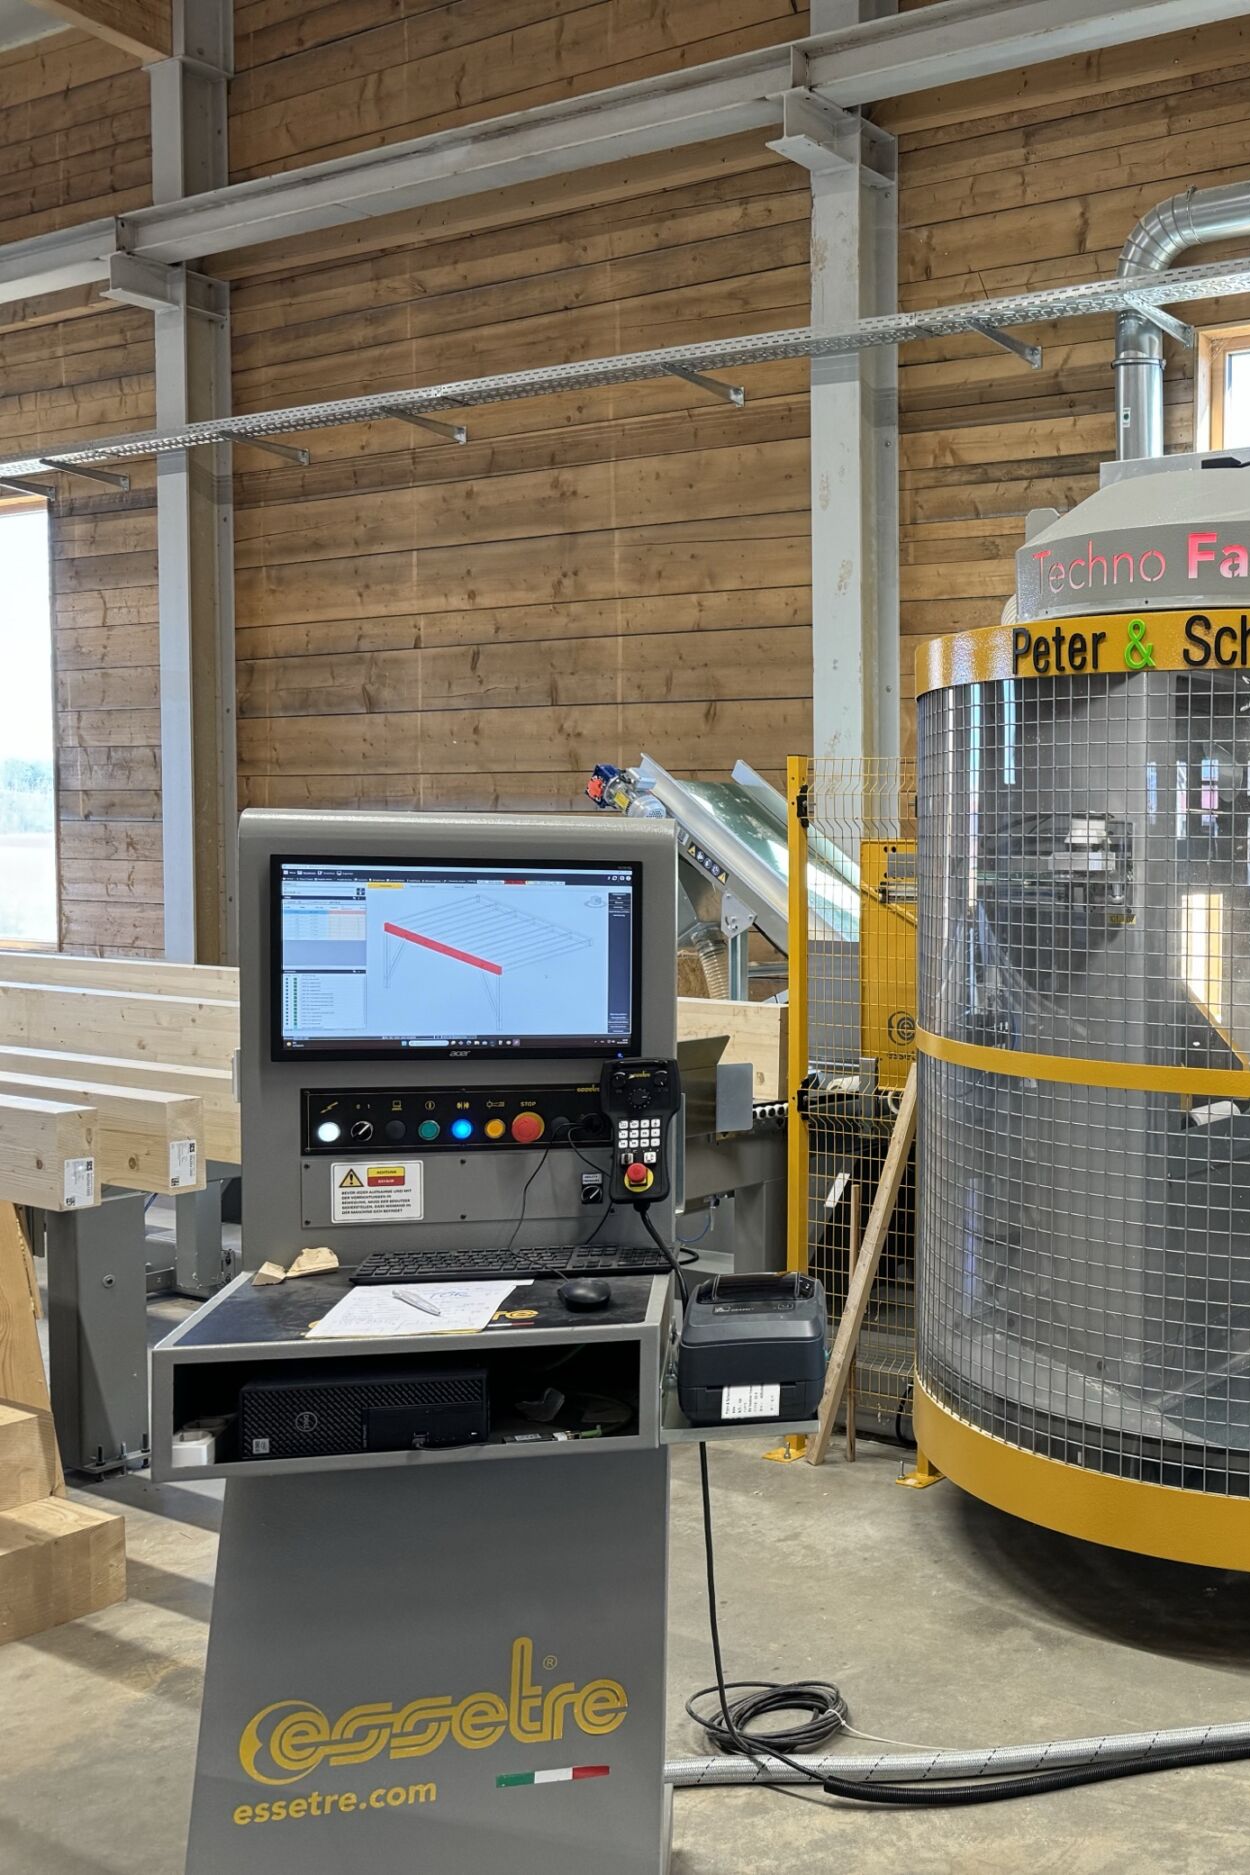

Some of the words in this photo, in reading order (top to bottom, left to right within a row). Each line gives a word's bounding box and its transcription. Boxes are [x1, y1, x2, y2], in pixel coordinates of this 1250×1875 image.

[1032, 540, 1167, 594] Techno
[1012, 625, 1106, 675] Peter
[1123, 617, 1156, 670] &
[269, 1636, 629, 1771] essetre
[233, 1779, 438, 1826] essetre.com
